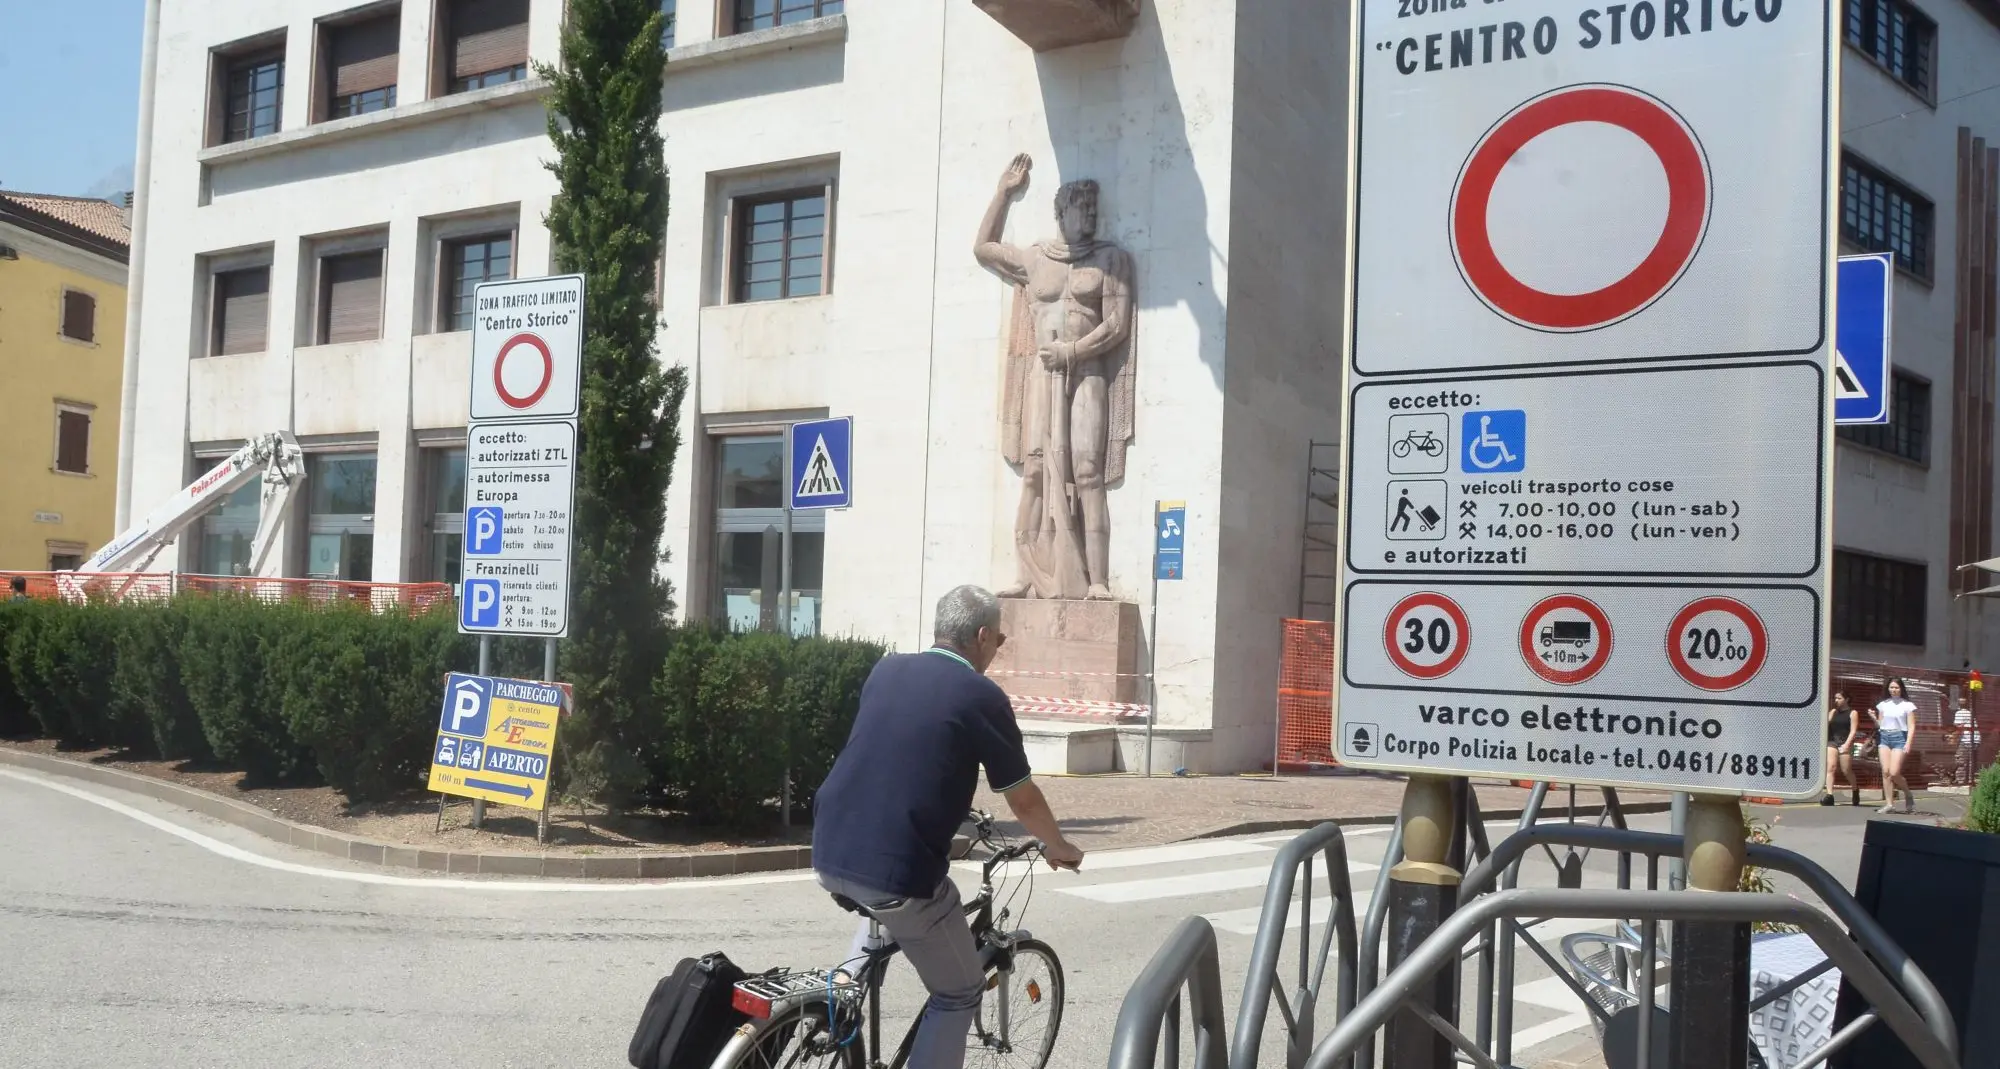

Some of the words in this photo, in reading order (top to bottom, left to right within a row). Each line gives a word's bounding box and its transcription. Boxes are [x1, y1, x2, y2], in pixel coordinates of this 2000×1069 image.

[1578, 0, 1782, 49] STORICO
[480, 297, 499, 310] ZONA
[503, 293, 537, 308] TRAFFICO
[541, 290, 577, 305] LIMITATO
[1388, 392, 1481, 410] eccetto:
[480, 432, 527, 444] eccetto:
[478, 449, 540, 462] autorizzati
[545, 448, 568, 460] ZTL
[191, 461, 231, 497] Palazzani
[477, 471, 550, 483] autorimessa
[1461, 480, 1522, 495] veicoli
[1528, 478, 1622, 496] trasporto
[1628, 480, 1674, 493] cose
[477, 489, 518, 503] Europa
[504, 510, 530, 520] apertura
[503, 525, 523, 534] sabato
[503, 540, 524, 549] festivo
[533, 540, 553, 549] chiuso
[1384, 550, 1396, 564] e
[1405, 546, 1527, 565] autorizzati
[476, 563, 539, 576] Franzinelli
[503, 581, 532, 590] riservato
[536, 581, 558, 590] clienti
[503, 593, 532, 603] apertura:
[1404, 617, 1450, 654] 30
[496, 683, 557, 703] PARCHEGGIO
[518, 706, 541, 714] centro
[1419, 704, 1509, 727] varco
[1521, 704, 1722, 739] elettronico
[1384, 733, 1440, 759] Corpo
[1449, 736, 1517, 760] Polizia
[488, 751, 544, 775] APERTO
[437, 772, 451, 784] 100
[453, 777, 461, 785] m
